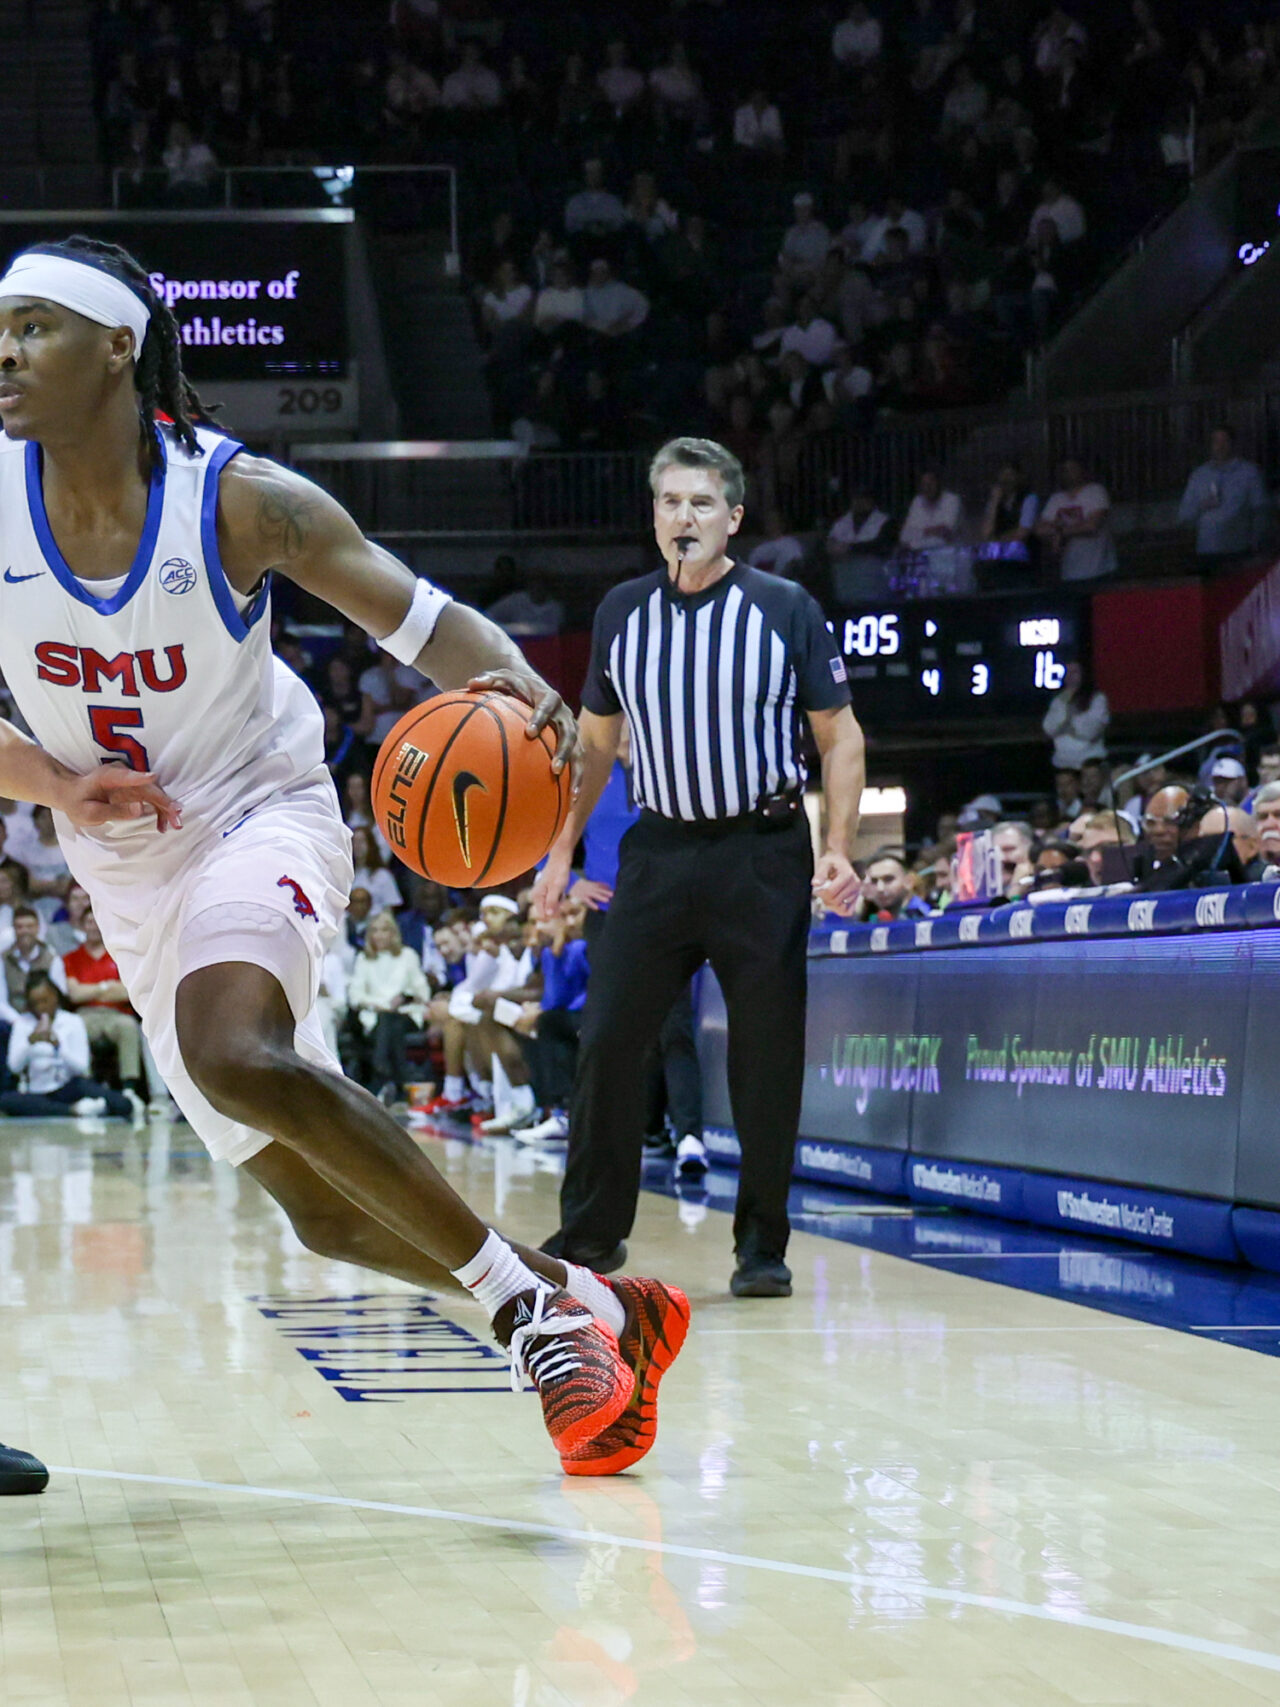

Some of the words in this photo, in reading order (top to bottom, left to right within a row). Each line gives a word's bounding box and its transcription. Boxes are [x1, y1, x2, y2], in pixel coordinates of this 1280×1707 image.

[147, 271, 262, 308] Sponsor
[266, 269, 302, 300] of
[177, 316, 286, 347] thletics
[277, 387, 344, 416] 209
[163, 566, 194, 582] ACC
[34, 641, 188, 698] SMU
[922, 668, 940, 697] 4
[971, 663, 989, 696] 3
[87, 705, 150, 774] 5
[387, 743, 430, 849] ELITE
[1009, 1034, 1072, 1098] Sponsor
[1075, 1034, 1096, 1088] of
[1097, 1036, 1140, 1091] SMU
[1141, 1034, 1228, 1097] Athletics
